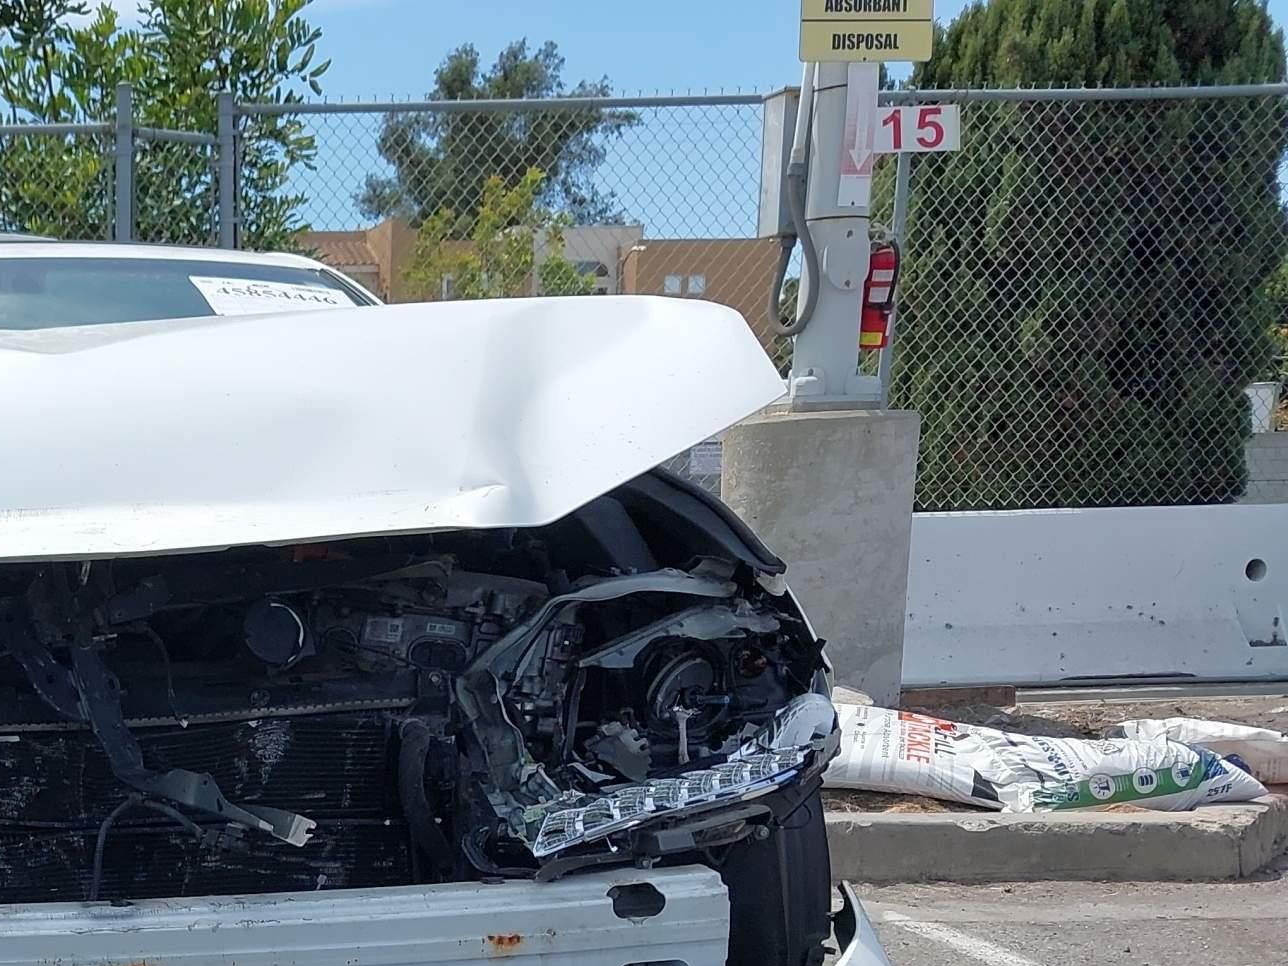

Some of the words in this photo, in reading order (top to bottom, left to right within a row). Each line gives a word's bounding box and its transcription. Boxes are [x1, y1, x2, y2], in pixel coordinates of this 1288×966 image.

[824, 0, 908, 12] ABSORBANT
[832, 33, 900, 50] DISPOSAL
[882, 107, 945, 150] 15
